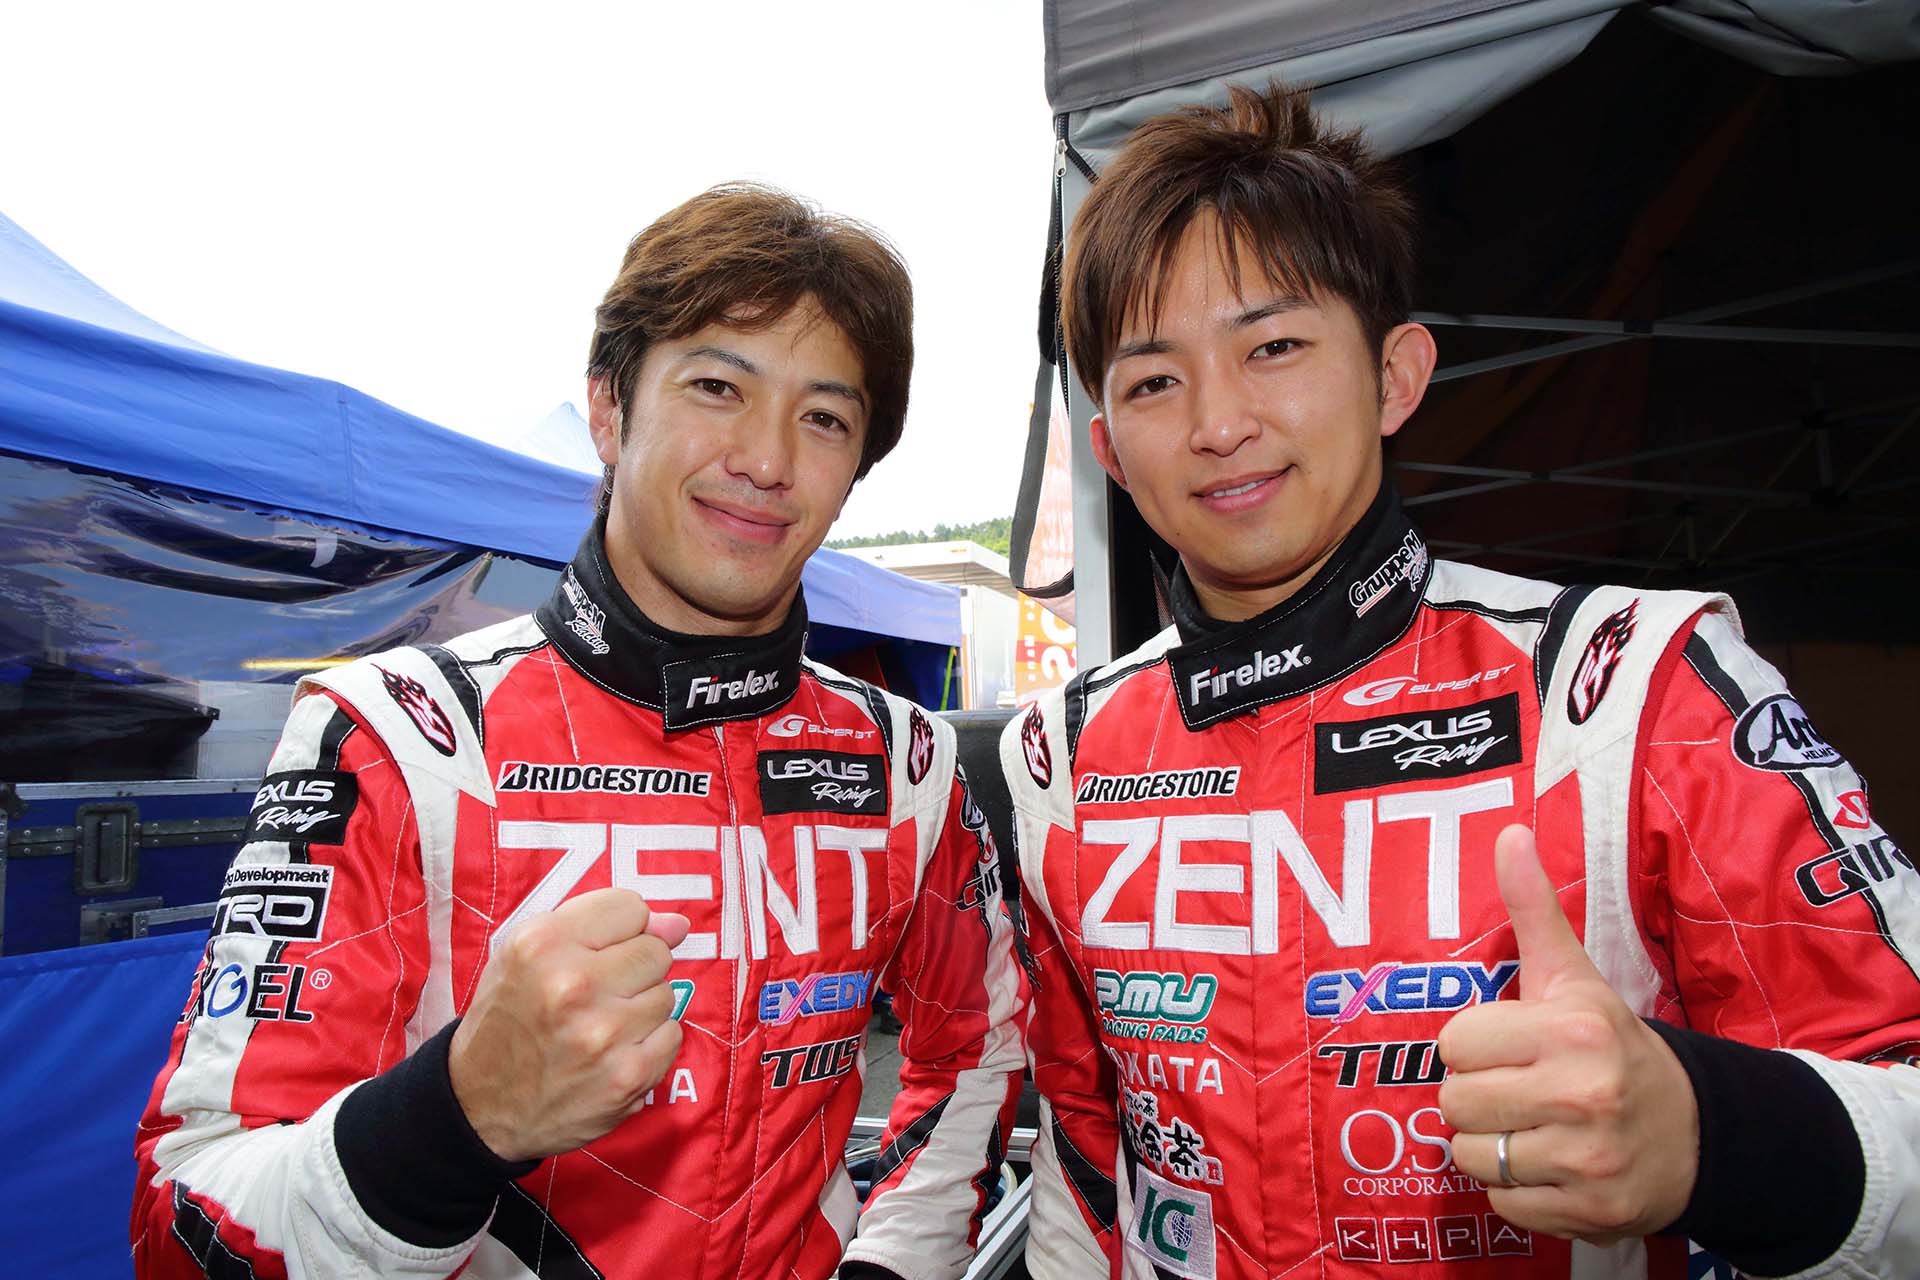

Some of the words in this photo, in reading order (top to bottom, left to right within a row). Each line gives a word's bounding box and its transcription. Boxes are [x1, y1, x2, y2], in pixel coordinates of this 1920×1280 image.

[1408, 672, 1481, 694] SUPER
[1332, 710, 1492, 753] LEXUS
[1393, 735, 1508, 770] Racing
[498, 763, 709, 796] BRIDGESTONE
[767, 758, 869, 781] LEXUS
[1077, 768, 1237, 803] BRIDGESTONE
[250, 781, 335, 812] EXUS
[811, 782, 880, 808] Racing
[256, 806, 341, 833] Racing
[233, 868, 329, 887] Development
[1080, 777, 1513, 956] ZENT
[490, 821, 888, 961] ZENT
[759, 970, 874, 1026] EXEDY
[1306, 960, 1520, 1022] EXEDY
[1102, 1018, 1150, 1040] RACING
[1150, 1024, 1208, 1043] PADS
[761, 1035, 862, 1089] TWS
[1344, 1174, 1488, 1197] CORPORATIO
